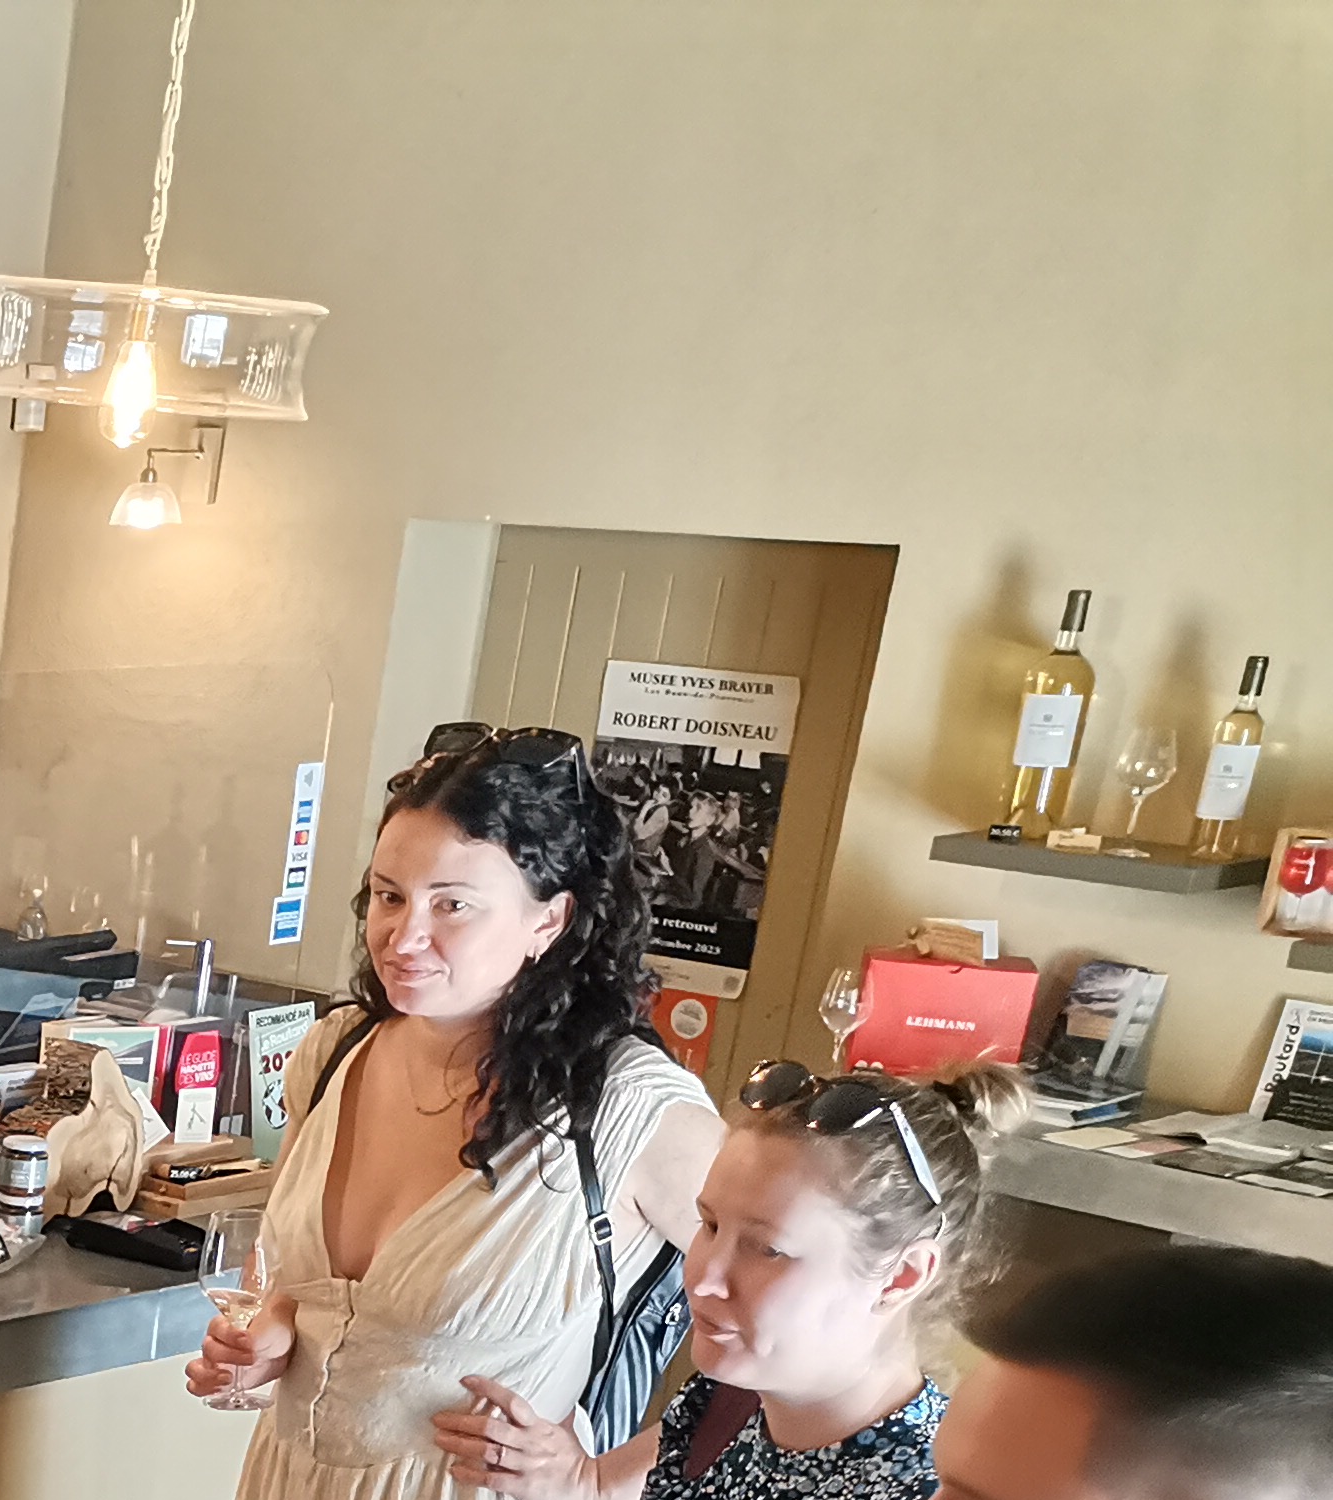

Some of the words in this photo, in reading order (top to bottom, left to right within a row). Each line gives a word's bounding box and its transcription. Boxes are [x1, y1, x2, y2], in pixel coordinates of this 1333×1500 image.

[681, 676, 715, 689] YVES
[718, 679, 774, 695] BRAYER
[613, 711, 680, 731] ROBERT
[685, 719, 779, 741] DOISNEAU
[906, 1016, 976, 1031] LEHMANN
[192, 1050, 217, 1063] GUIDE
[1264, 1024, 1300, 1092] Routard
[180, 1061, 215, 1074] HACHETTE
[194, 1070, 214, 1083] VINS
